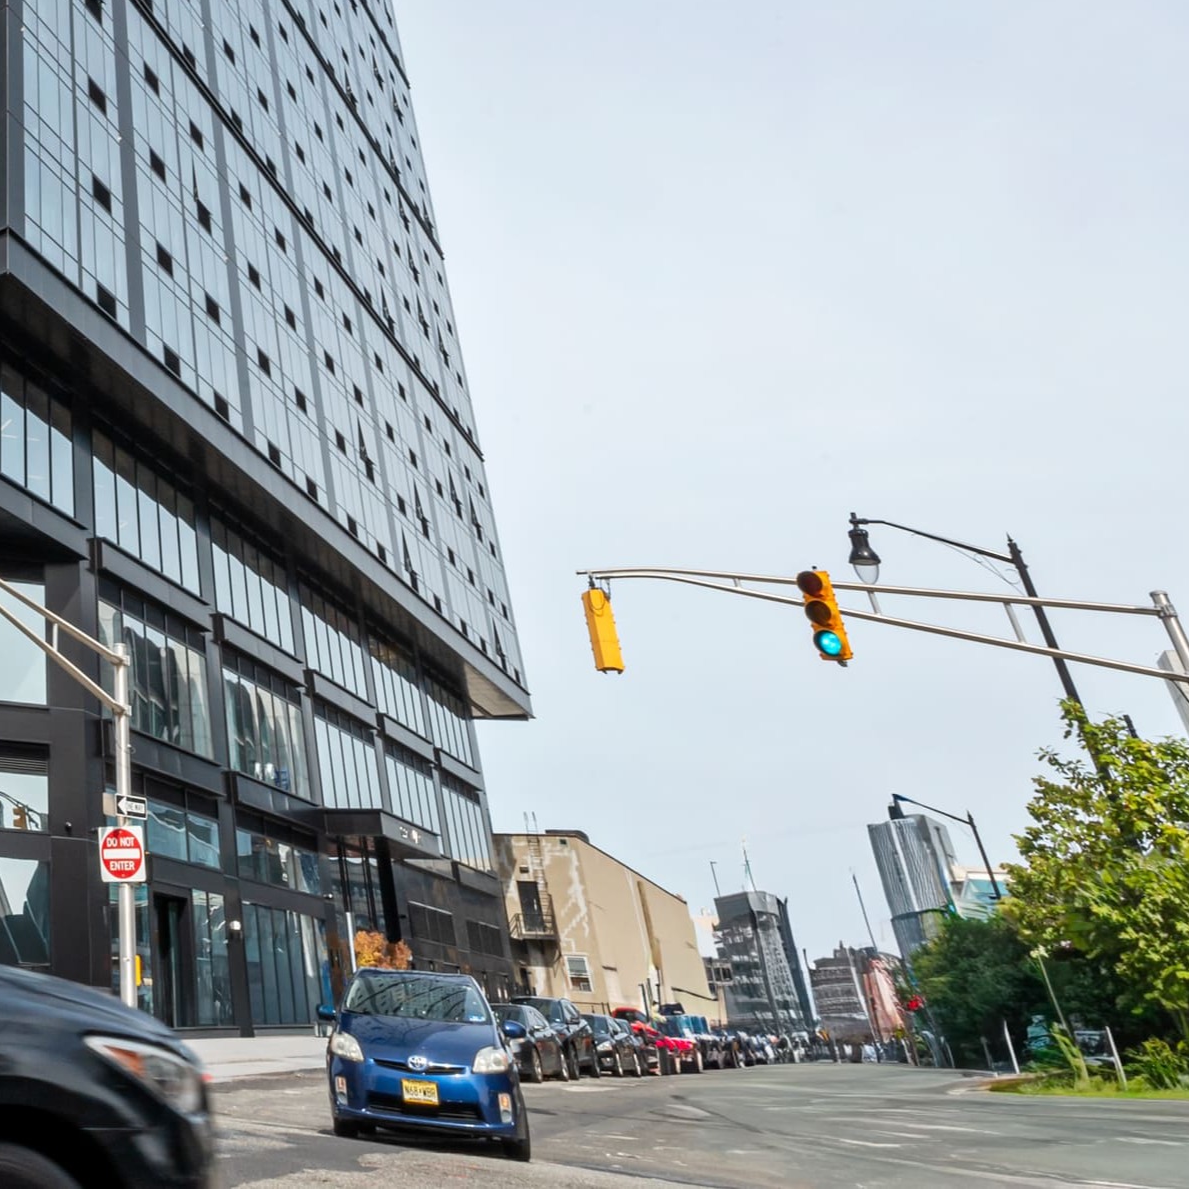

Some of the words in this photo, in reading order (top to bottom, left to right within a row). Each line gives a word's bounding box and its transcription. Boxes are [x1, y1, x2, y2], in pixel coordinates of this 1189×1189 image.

[106, 837, 118, 847] DO
[119, 837, 135, 847] NOT
[110, 861, 136, 871] ENTER
